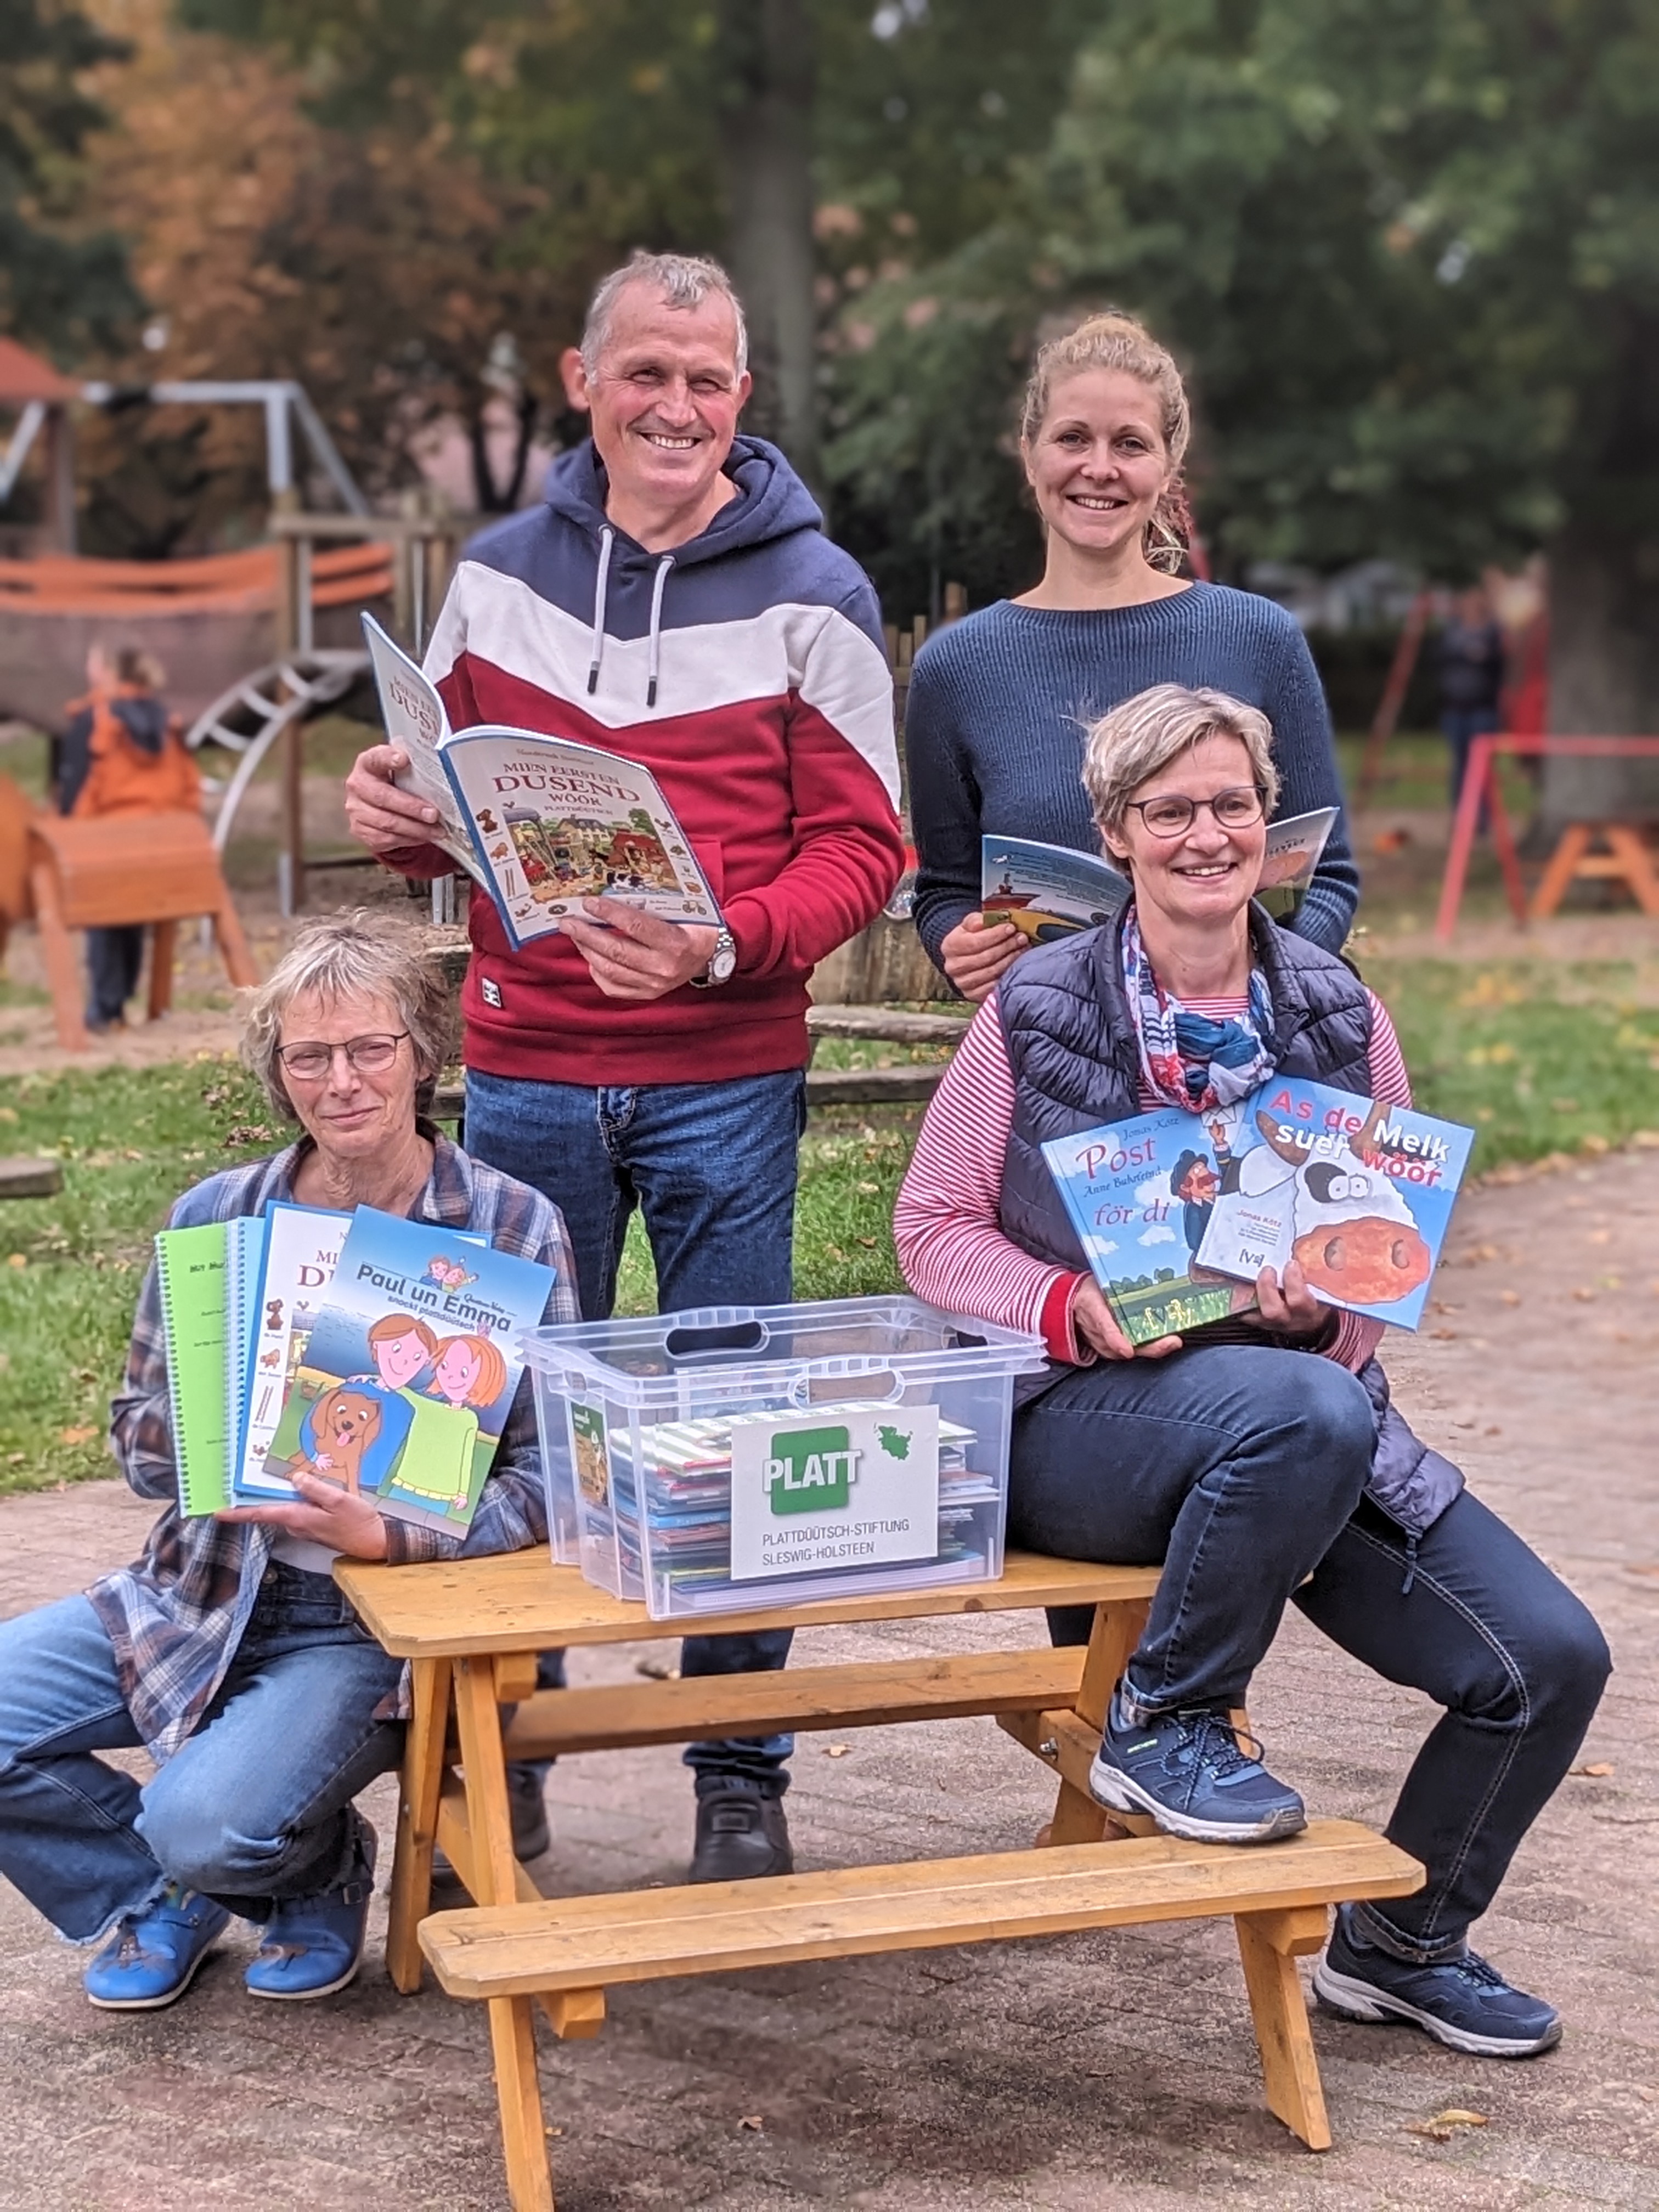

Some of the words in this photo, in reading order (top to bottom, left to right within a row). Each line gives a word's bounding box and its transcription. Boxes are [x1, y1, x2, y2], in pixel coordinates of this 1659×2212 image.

[503, 762, 548, 774] MIEN
[551, 765, 620, 785] EERSTEN
[492, 775, 641, 802] DUSEND
[1123, 1125, 1152, 1141] Jonas
[1269, 1090, 1313, 1120] As
[1324, 1107, 1362, 1134] de
[1373, 1119, 1452, 1164] Melk
[1075, 1137, 1156, 1180] Post
[1275, 1125, 1351, 1159] suer
[1362, 1148, 1443, 1187] wöör
[1083, 1183, 1110, 1198] Anne
[1094, 1203, 1133, 1226] för
[1142, 1198, 1171, 1223] di
[1236, 1209, 1261, 1221] Jonas
[357, 1263, 407, 1295] Paul
[410, 1286, 438, 1307] un
[443, 1294, 512, 1332] Emma
[762, 1448, 864, 1493] PLATT
[762, 1519, 910, 1547] PLATTDÜÜTSCH-STIFTUNG
[762, 1541, 874, 1566] SLESWIG-HOLSTEEN
